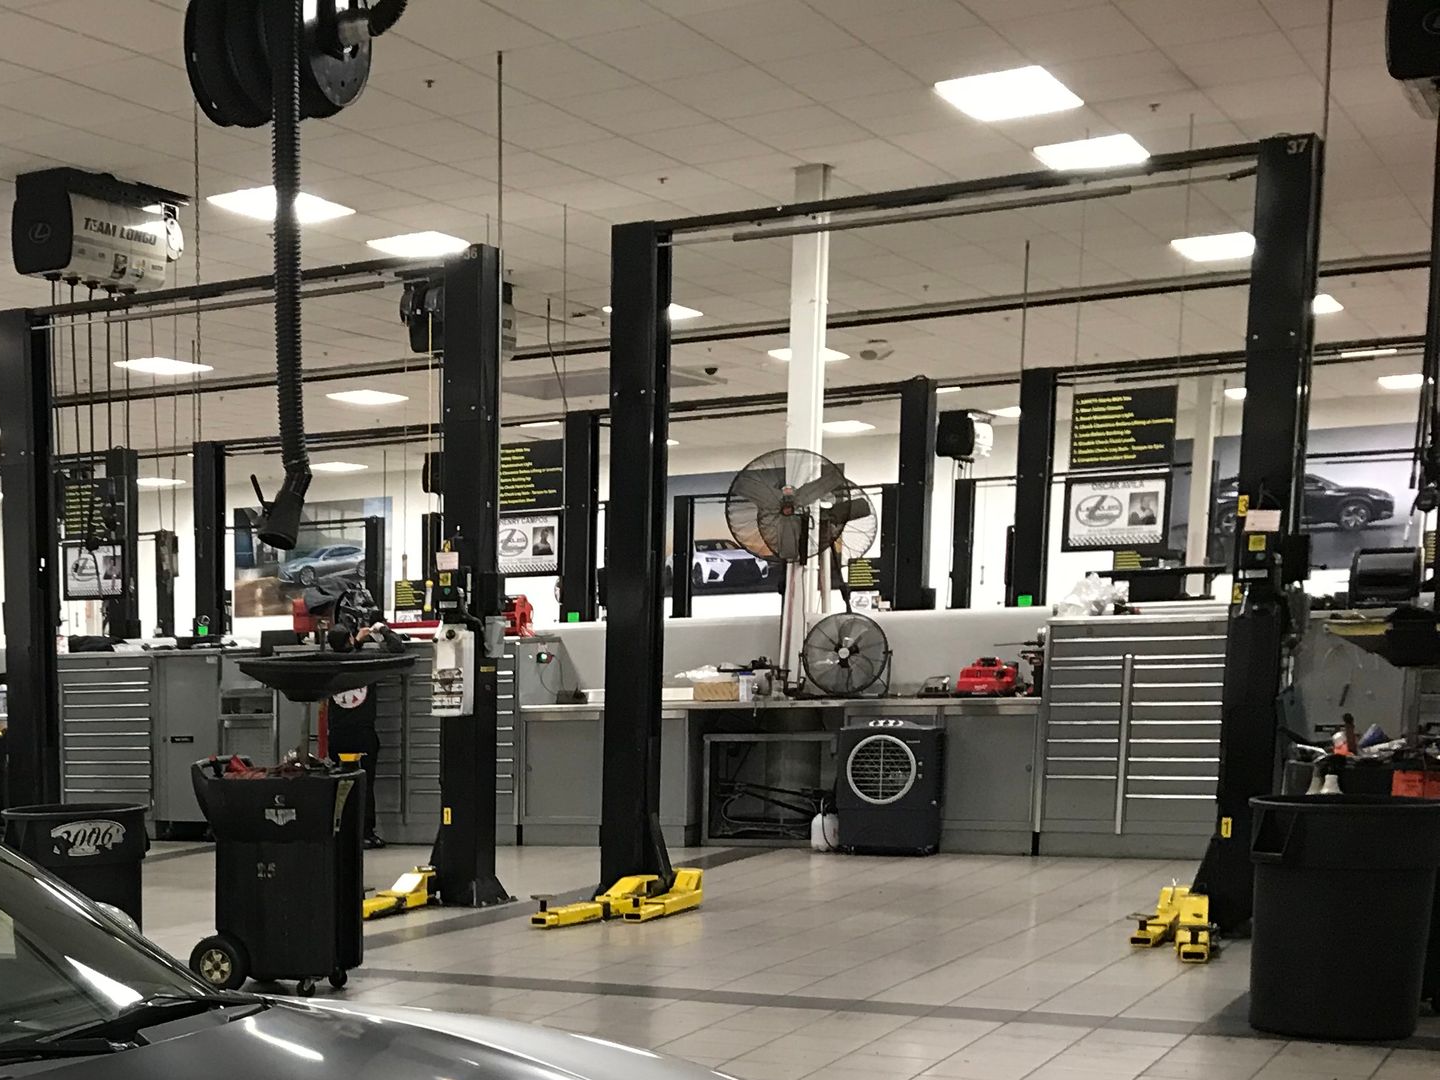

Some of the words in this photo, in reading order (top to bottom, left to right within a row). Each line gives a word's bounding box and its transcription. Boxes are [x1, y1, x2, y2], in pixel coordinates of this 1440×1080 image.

[1287, 139, 1308, 154] 37
[83, 217, 117, 237] TEAM
[119, 226, 157, 246] LONGO
